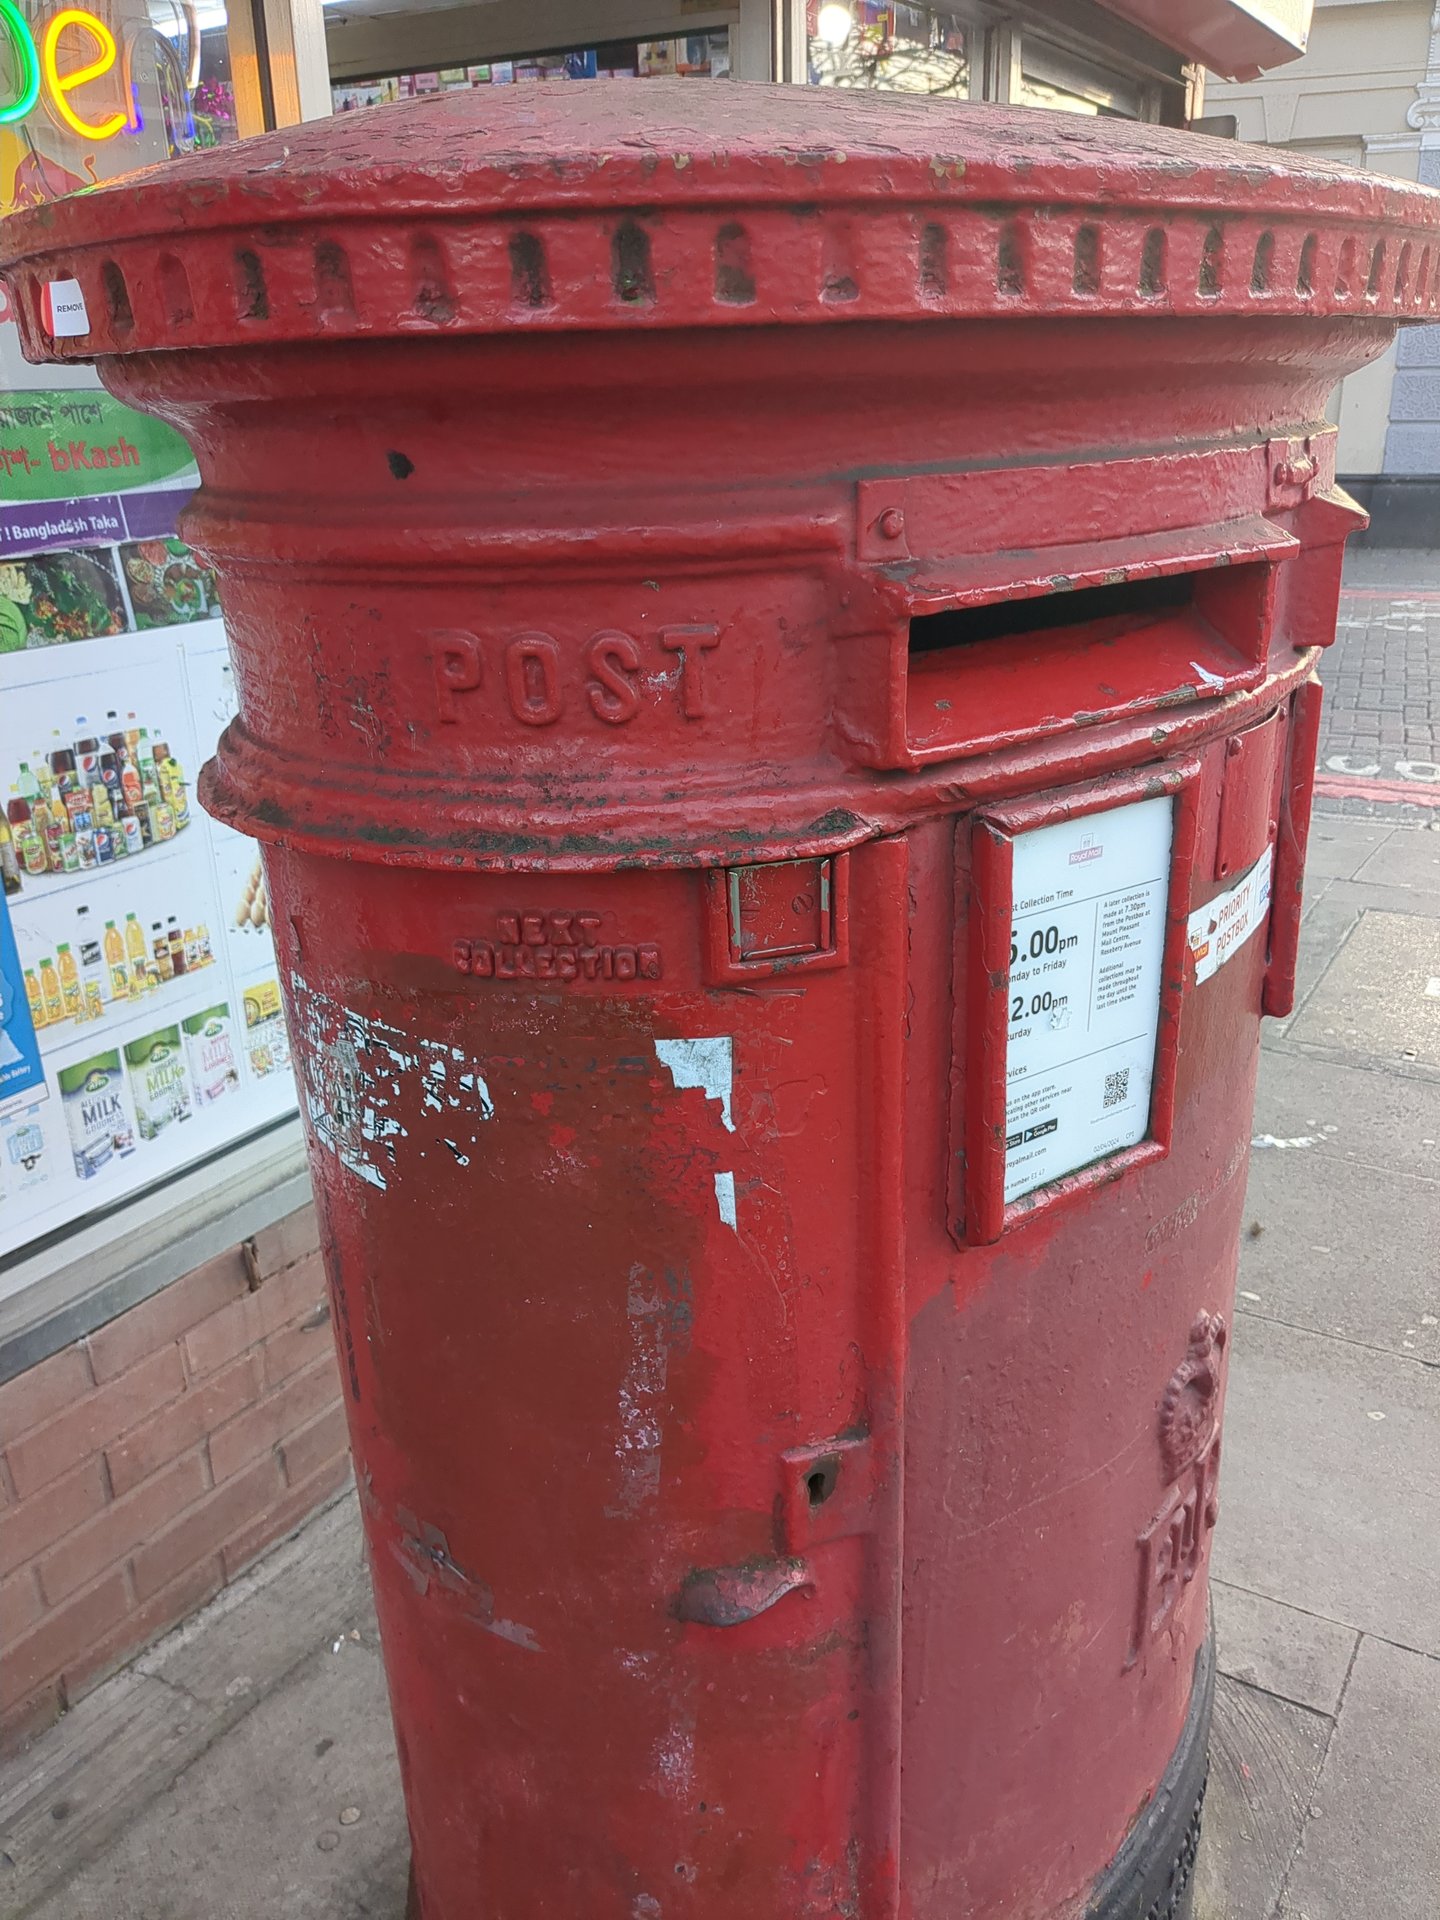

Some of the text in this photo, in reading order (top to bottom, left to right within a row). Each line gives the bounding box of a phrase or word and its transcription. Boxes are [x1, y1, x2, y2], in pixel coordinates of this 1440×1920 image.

[57, 302, 84, 313] REMOVE
[47, 437, 140, 473] bKash
[12, 516, 88, 540] Bangladesh
[88, 514, 119, 530] Taka
[429, 622, 722, 726] POST
[1070, 851, 1089, 863] Royal
[1020, 894, 1055, 910] Collection
[1056, 889, 1073, 900] Time
[1109, 899, 1120, 907] later
[1121, 892, 1145, 904] collection
[1218, 883, 1251, 928] PRIORITY
[1103, 911, 1117, 919] made
[1125, 902, 1146, 913] 7.30pm
[1125, 912, 1144, 922] Postbox
[497, 908, 602, 947] NEXT
[1101, 921, 1140, 938] Mount Pleasant
[1216, 909, 1249, 955] POSTBOX
[1101, 938, 1112, 947] Mail
[1124, 939, 1142, 949] Avenue
[453, 938, 663, 980] COLLECTION
[1033, 967, 1040, 976] to
[1043, 959, 1067, 972] Friday
[1099, 961, 1124, 974] Additional
[1098, 971, 1124, 983] collections
[1112, 974, 1139, 988] throughout
[1008, 991, 1068, 1021] 2.00pm
[1040, 1091, 1060, 1102] services
[82, 1094, 122, 1126] MILK
[1033, 1127, 1048, 1138] Google
[1007, 1147, 1047, 1168] royalmail.com
[1011, 1175, 1030, 1188] number
